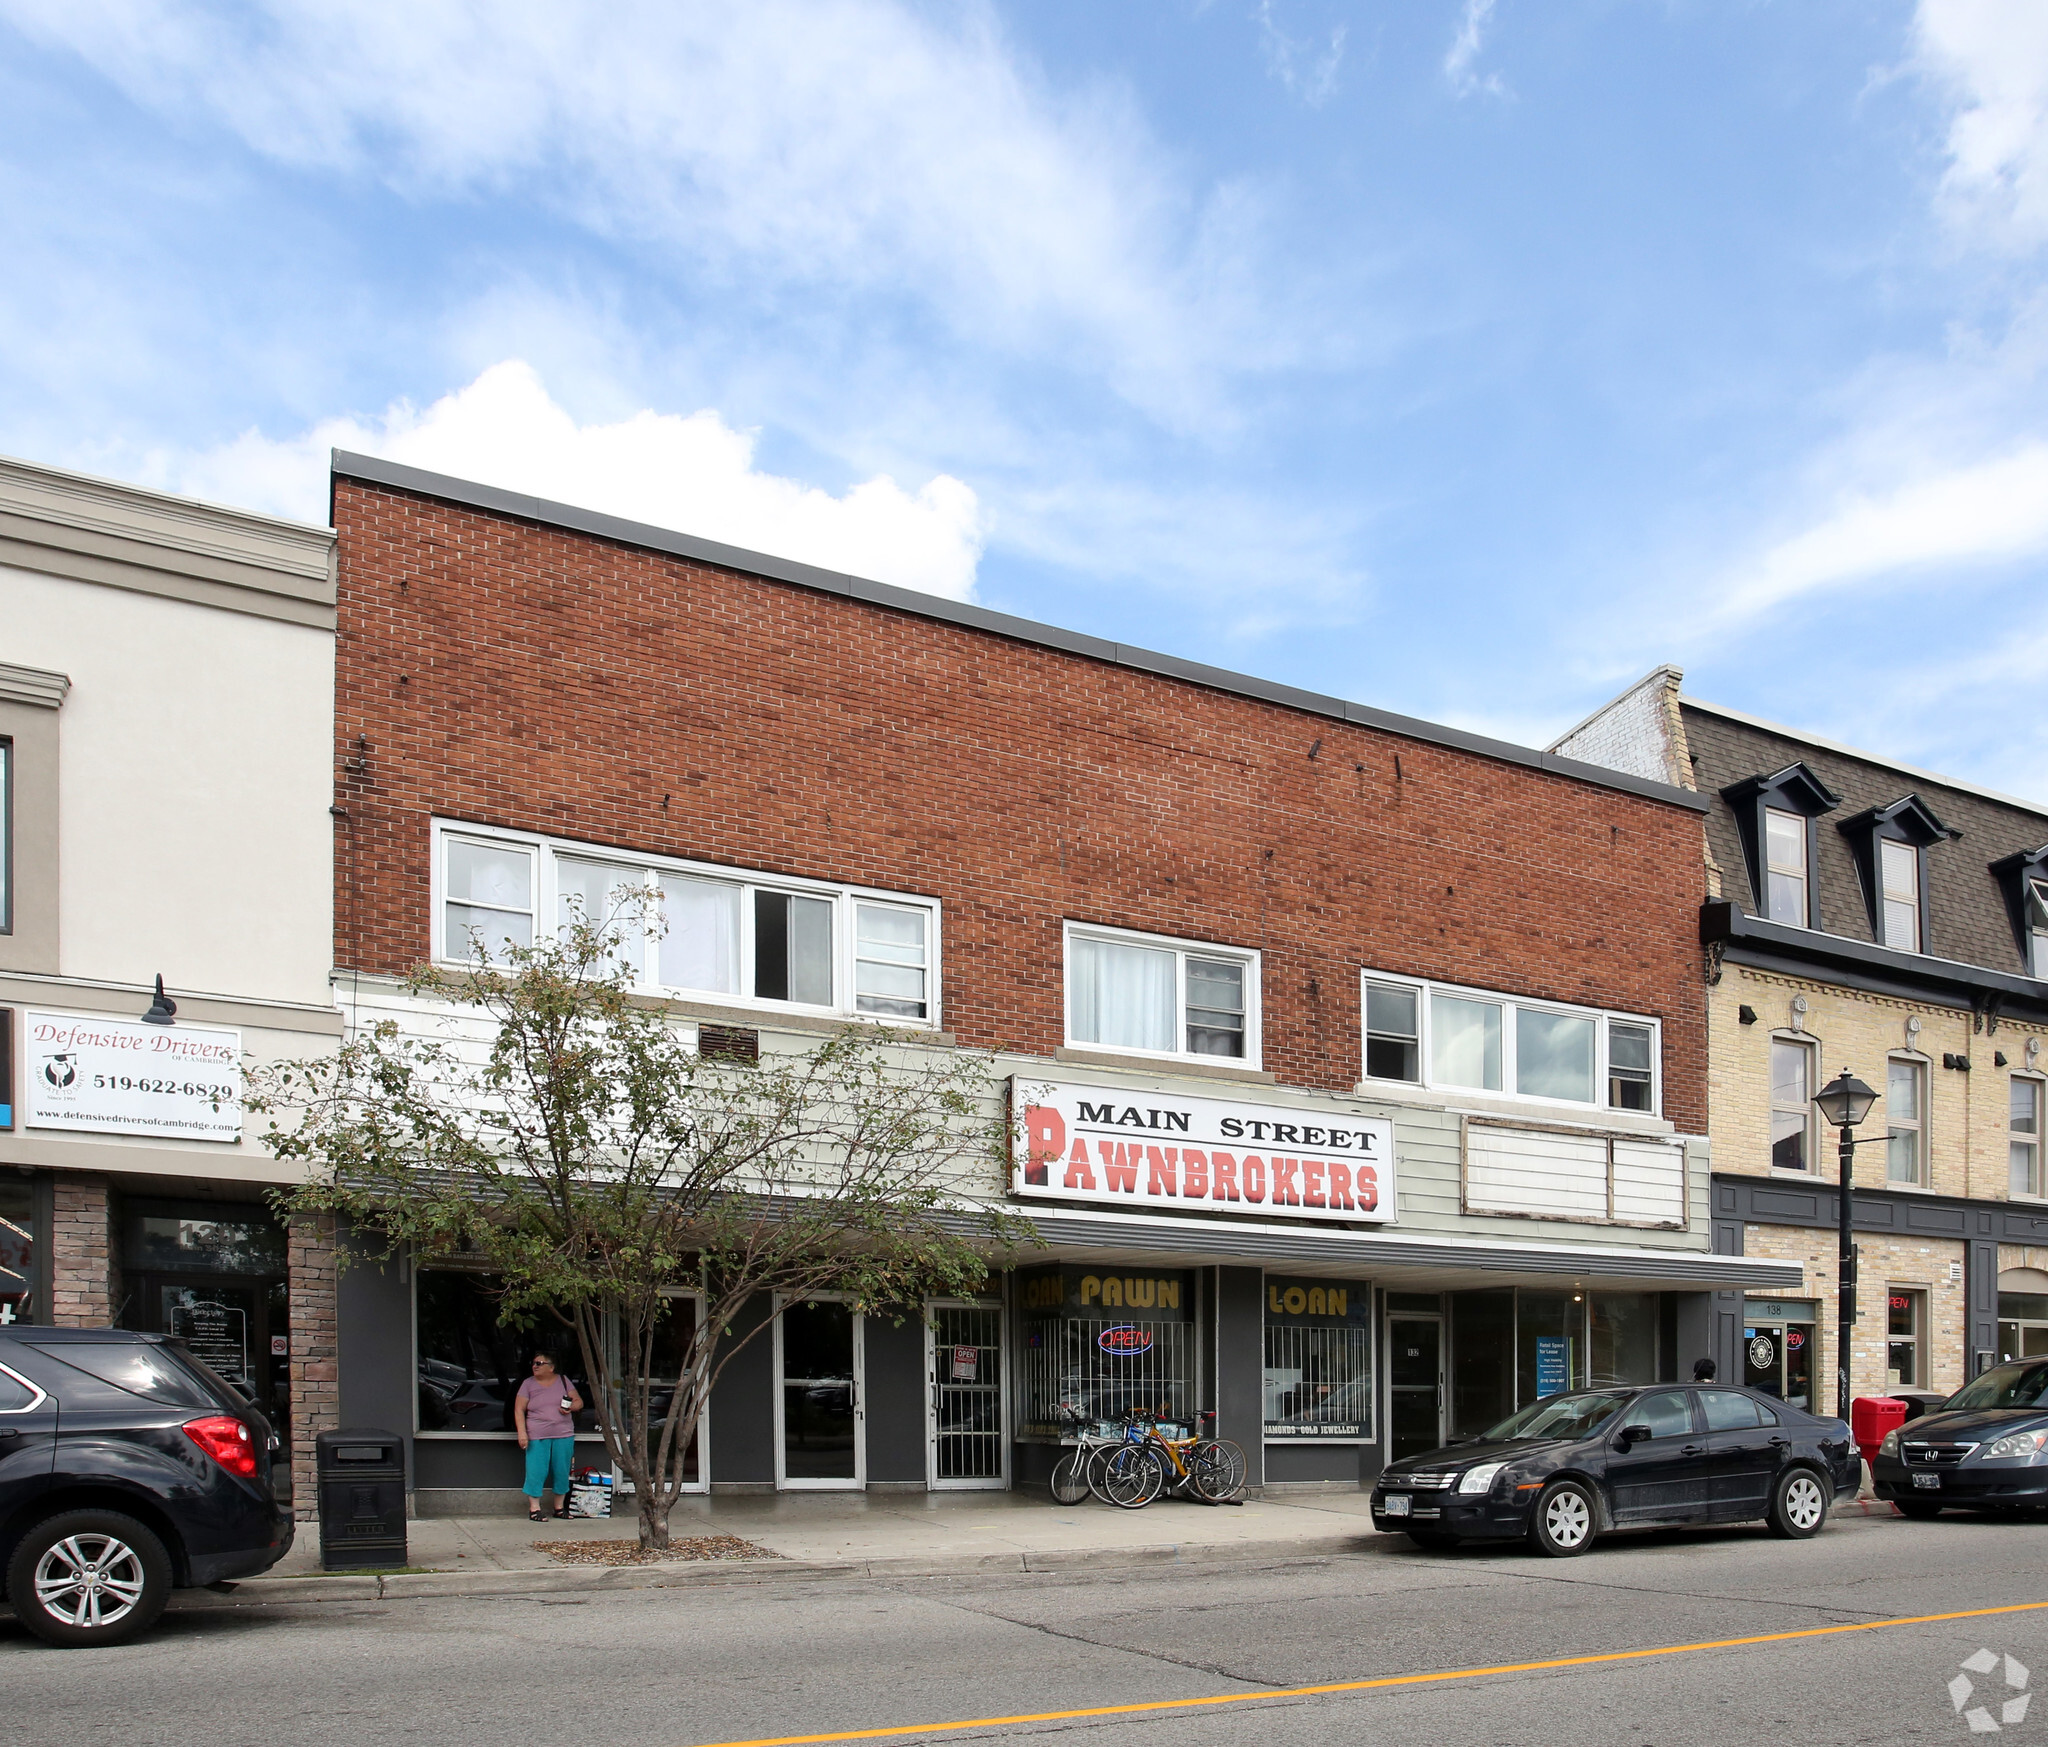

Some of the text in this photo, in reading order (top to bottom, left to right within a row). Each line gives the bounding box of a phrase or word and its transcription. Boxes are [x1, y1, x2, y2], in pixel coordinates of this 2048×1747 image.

[34, 1024, 233, 1058] Defensive Drivers
[93, 1074, 233, 1100] 519-622-6829
[36, 1109, 234, 1132] www.defensivedriversofcambridge.com
[1076, 1101, 1378, 1151] MAIN STREET
[1024, 1104, 1379, 1213] PAWNBROKERS
[180, 1223, 236, 1246] 120
[1081, 1275, 1179, 1309] PAWN
[1269, 1285, 1347, 1317] LOAN
[1767, 1305, 1782, 1315] 138
[1100, 1331, 1152, 1347] OPEN
[957, 1350, 975, 1359] OPEN
[1264, 1425, 1296, 1434] IAMONDS
[1320, 1425, 1360, 1435] JEWELLERY
